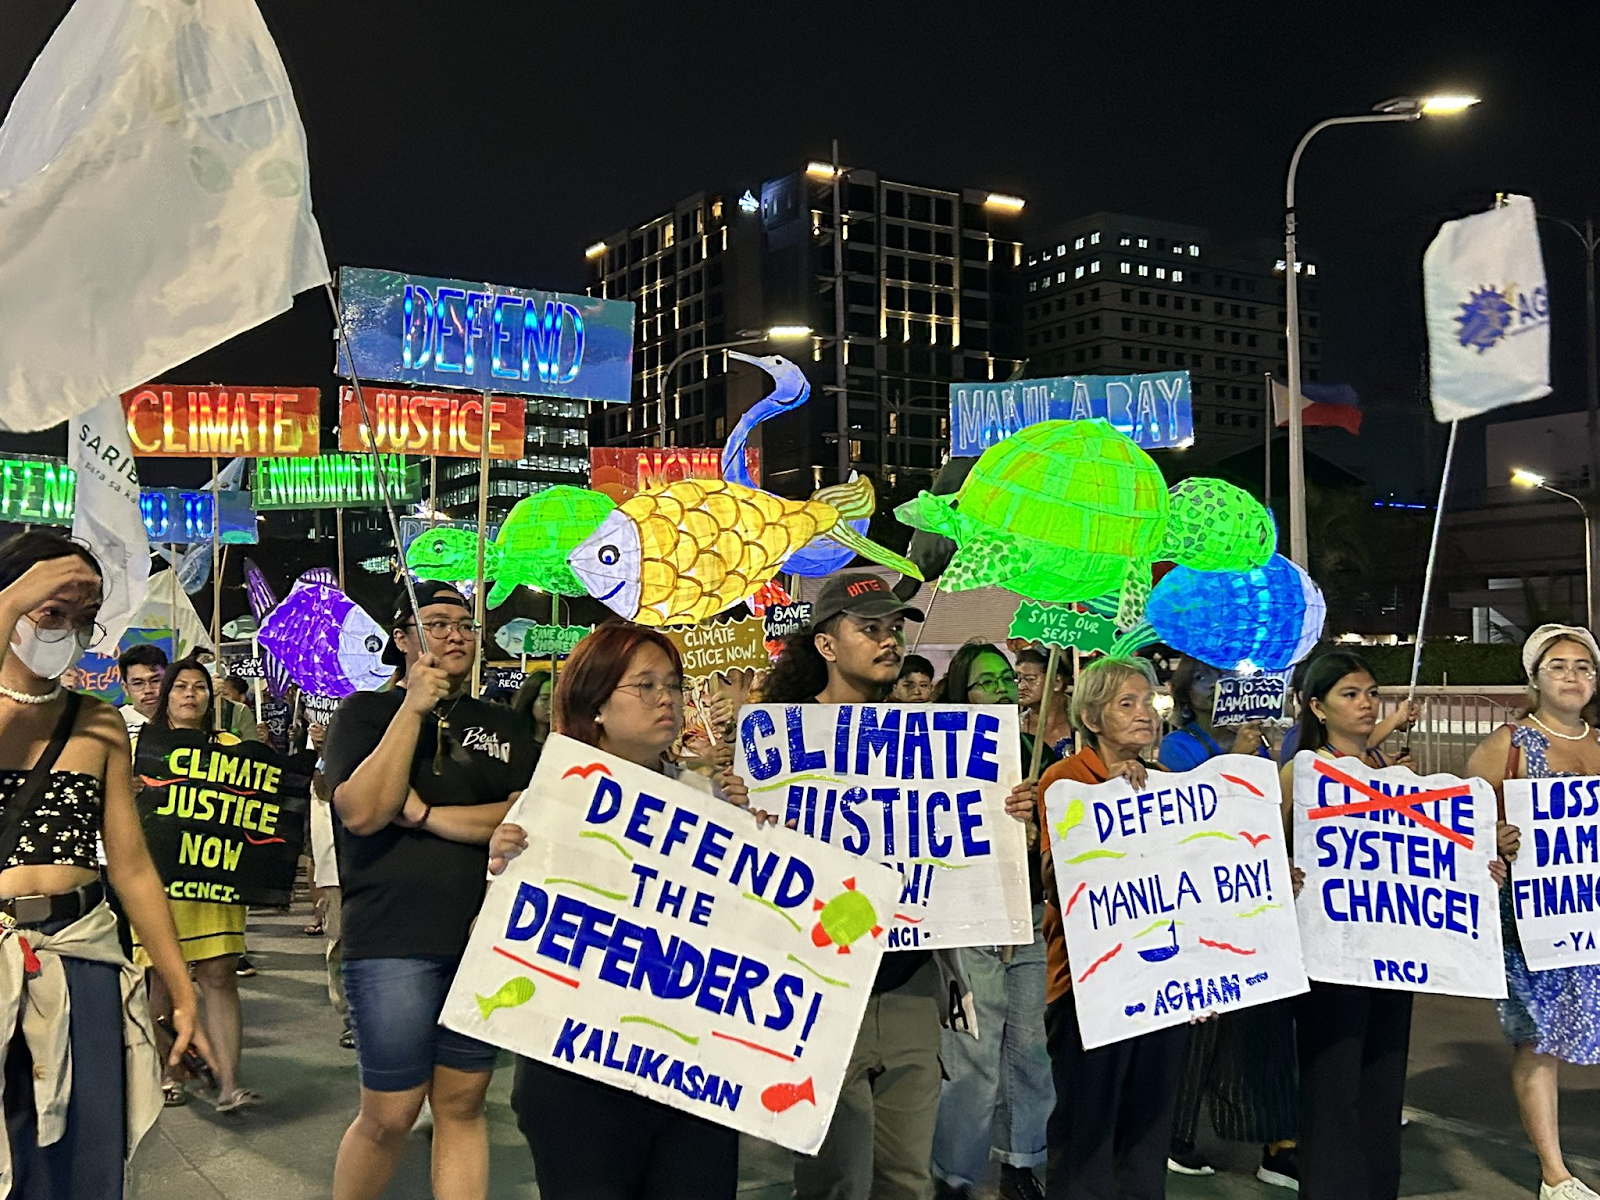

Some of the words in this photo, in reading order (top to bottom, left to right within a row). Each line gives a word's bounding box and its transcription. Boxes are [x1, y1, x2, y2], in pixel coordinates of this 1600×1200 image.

[402, 283, 585, 385] DEFEND
[127, 390, 303, 453] CLIMATE
[358, 392, 507, 455] JUSTICE
[0, 459, 77, 519] FEN
[256, 453, 414, 504] ENVIRONMENTAL
[773, 604, 811, 621] SAVE
[846, 579, 881, 597] BITE
[531, 628, 556, 641] SAVE
[684, 627, 736, 647] CLIMATE
[1028, 609, 1068, 628] SAVE
[1075, 617, 1100, 634] OUR
[1041, 627, 1082, 642] SEAS!
[242, 658, 262, 668] SAV
[681, 648, 724, 669] USTICE
[726, 639, 756, 663] NOW!
[1237, 680, 1254, 696] TO
[741, 704, 1000, 783] CLIMATE
[168, 747, 282, 794] CLIMATE
[156, 784, 281, 836] JUSTICE
[1092, 783, 1218, 844] DEFEND
[1317, 773, 1475, 837] CLIMATE
[1531, 779, 1600, 821] LOSS
[178, 832, 244, 872] NOW
[585, 776, 815, 909] DEFEND
[1315, 825, 1457, 882] SYSTEM
[631, 863, 716, 928] THE
[1088, 870, 1202, 930] MANILA
[1213, 858, 1273, 904] BAY!
[1321, 878, 1480, 940] CHANGE!
[505, 881, 823, 1058] DEFENDERS!
[1373, 958, 1429, 984] PRCJ
[552, 1017, 743, 1113] KALIKASAN
